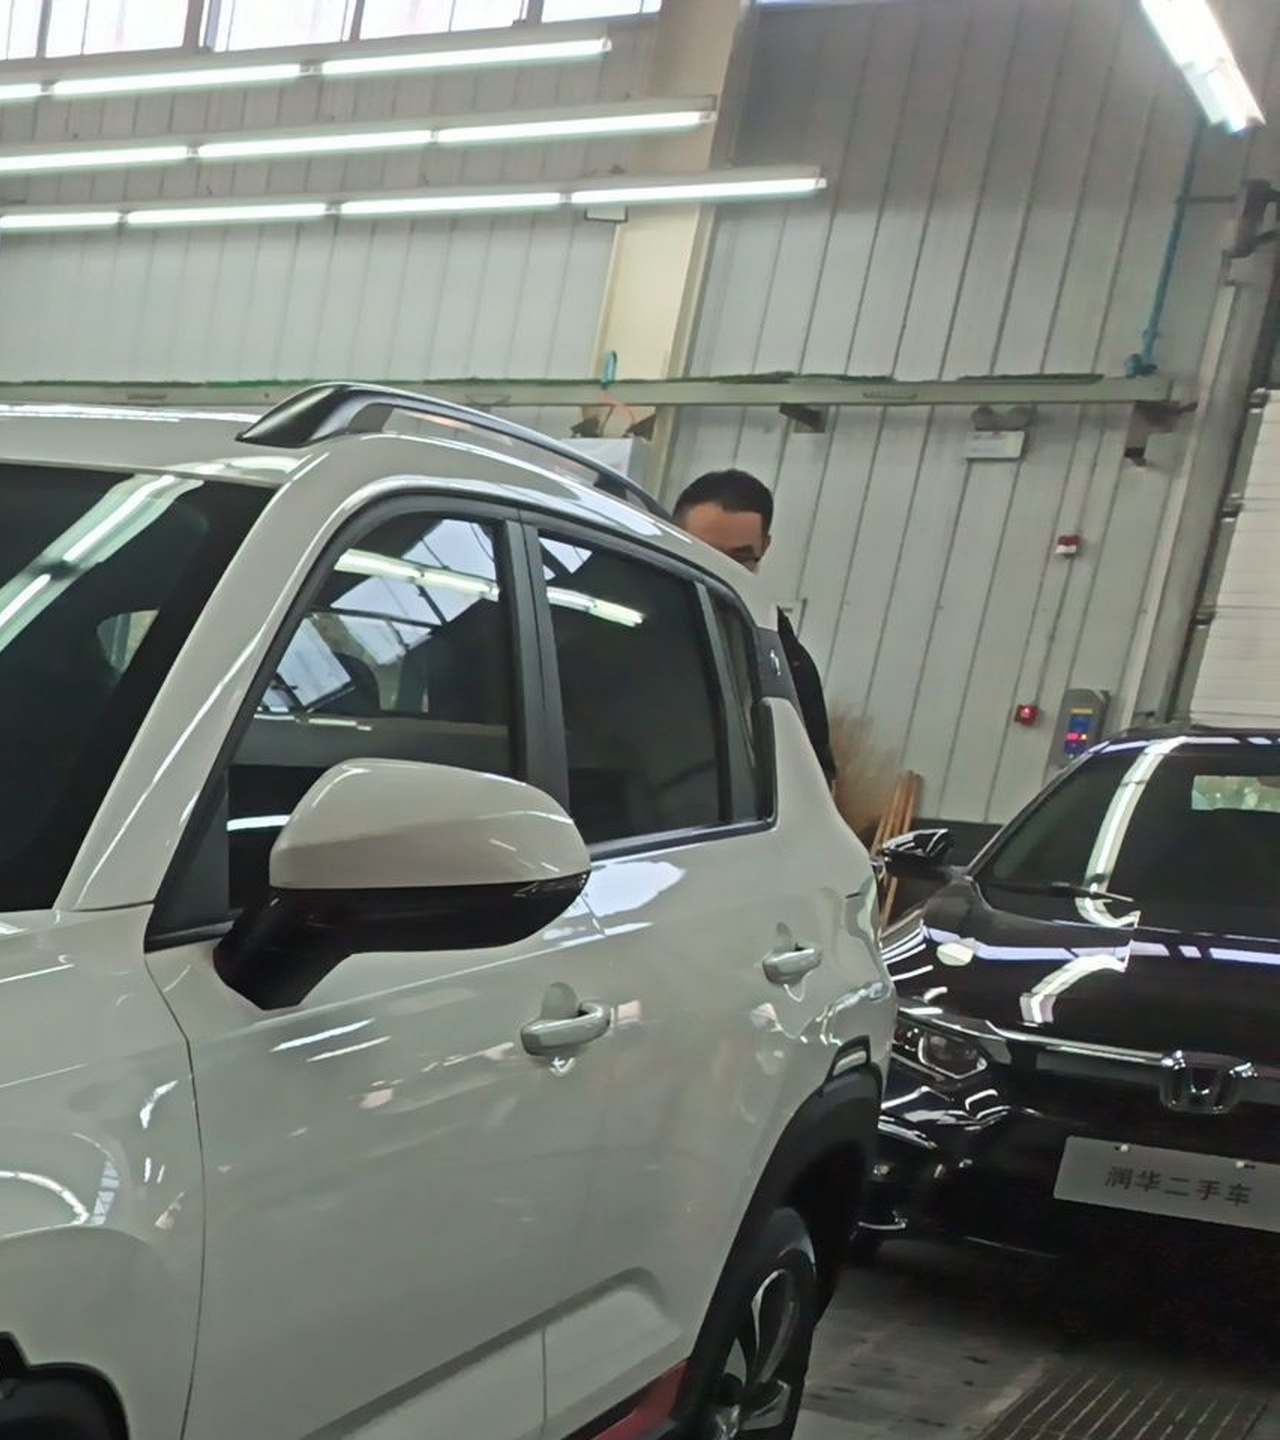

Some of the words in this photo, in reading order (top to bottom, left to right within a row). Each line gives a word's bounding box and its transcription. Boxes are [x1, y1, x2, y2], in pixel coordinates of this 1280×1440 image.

[1103, 1165, 1253, 1207] 润华二手车
